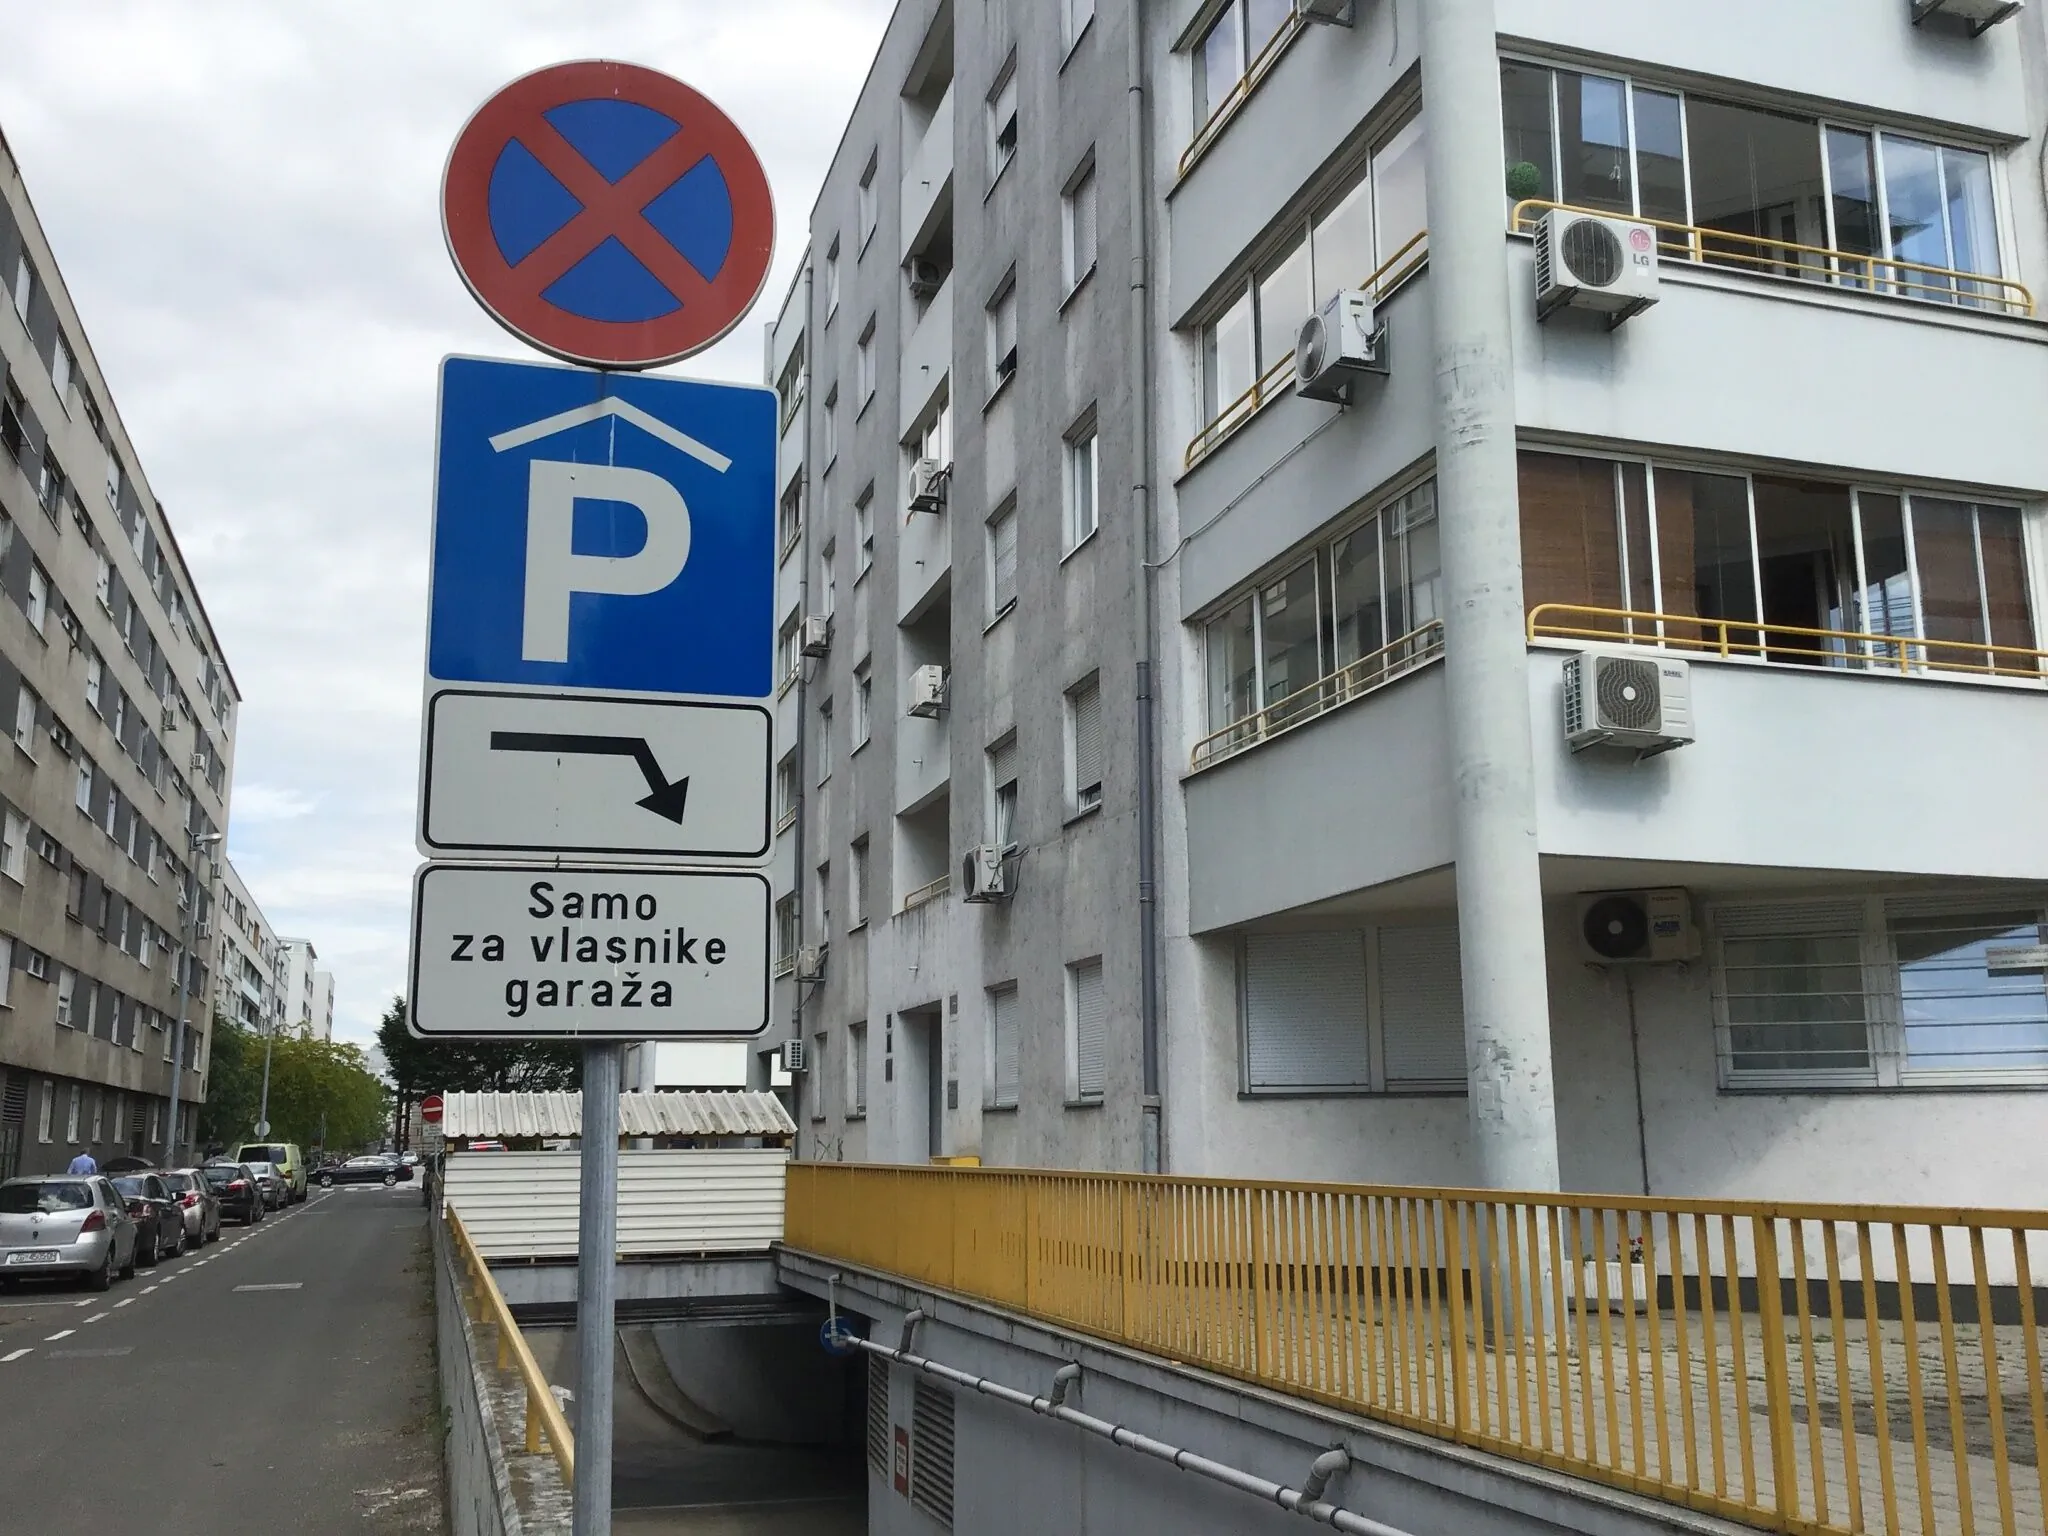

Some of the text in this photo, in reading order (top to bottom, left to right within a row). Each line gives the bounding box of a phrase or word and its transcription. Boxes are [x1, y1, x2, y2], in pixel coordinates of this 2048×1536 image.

[1633, 253, 1650, 266] LG
[522, 458, 691, 663] P
[528, 881, 657, 921] Samo
[450, 926, 727, 965] za vlasnike
[505, 971, 672, 1018] garaža
